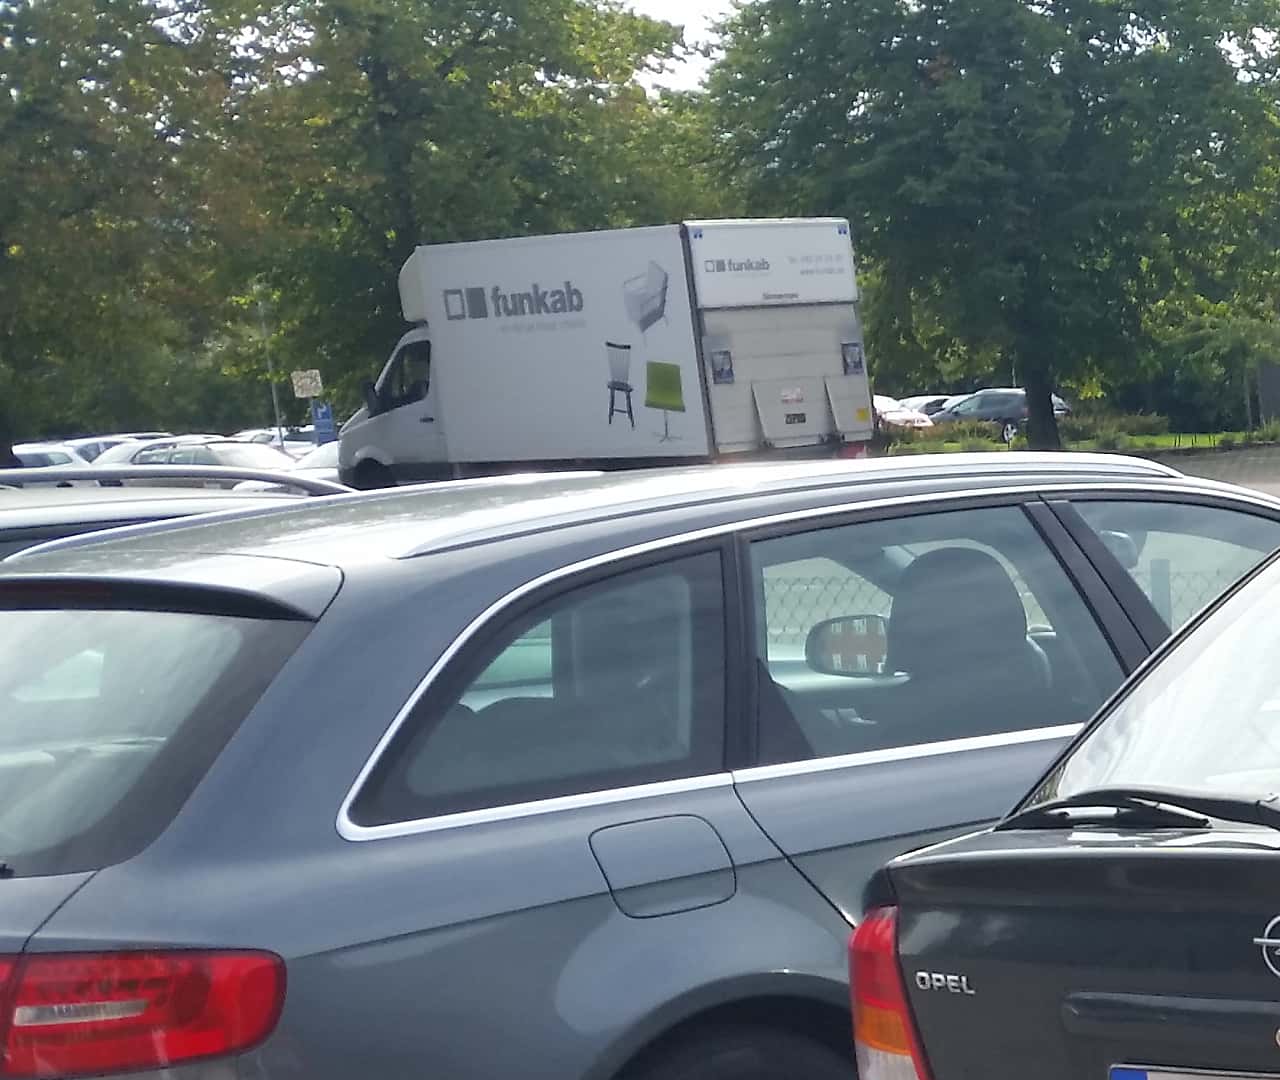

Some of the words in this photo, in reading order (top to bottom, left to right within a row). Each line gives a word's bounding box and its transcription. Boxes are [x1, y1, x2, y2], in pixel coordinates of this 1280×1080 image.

[728, 258, 771, 273] funkab
[491, 281, 584, 318] funkab
[915, 971, 976, 995] OPEL
